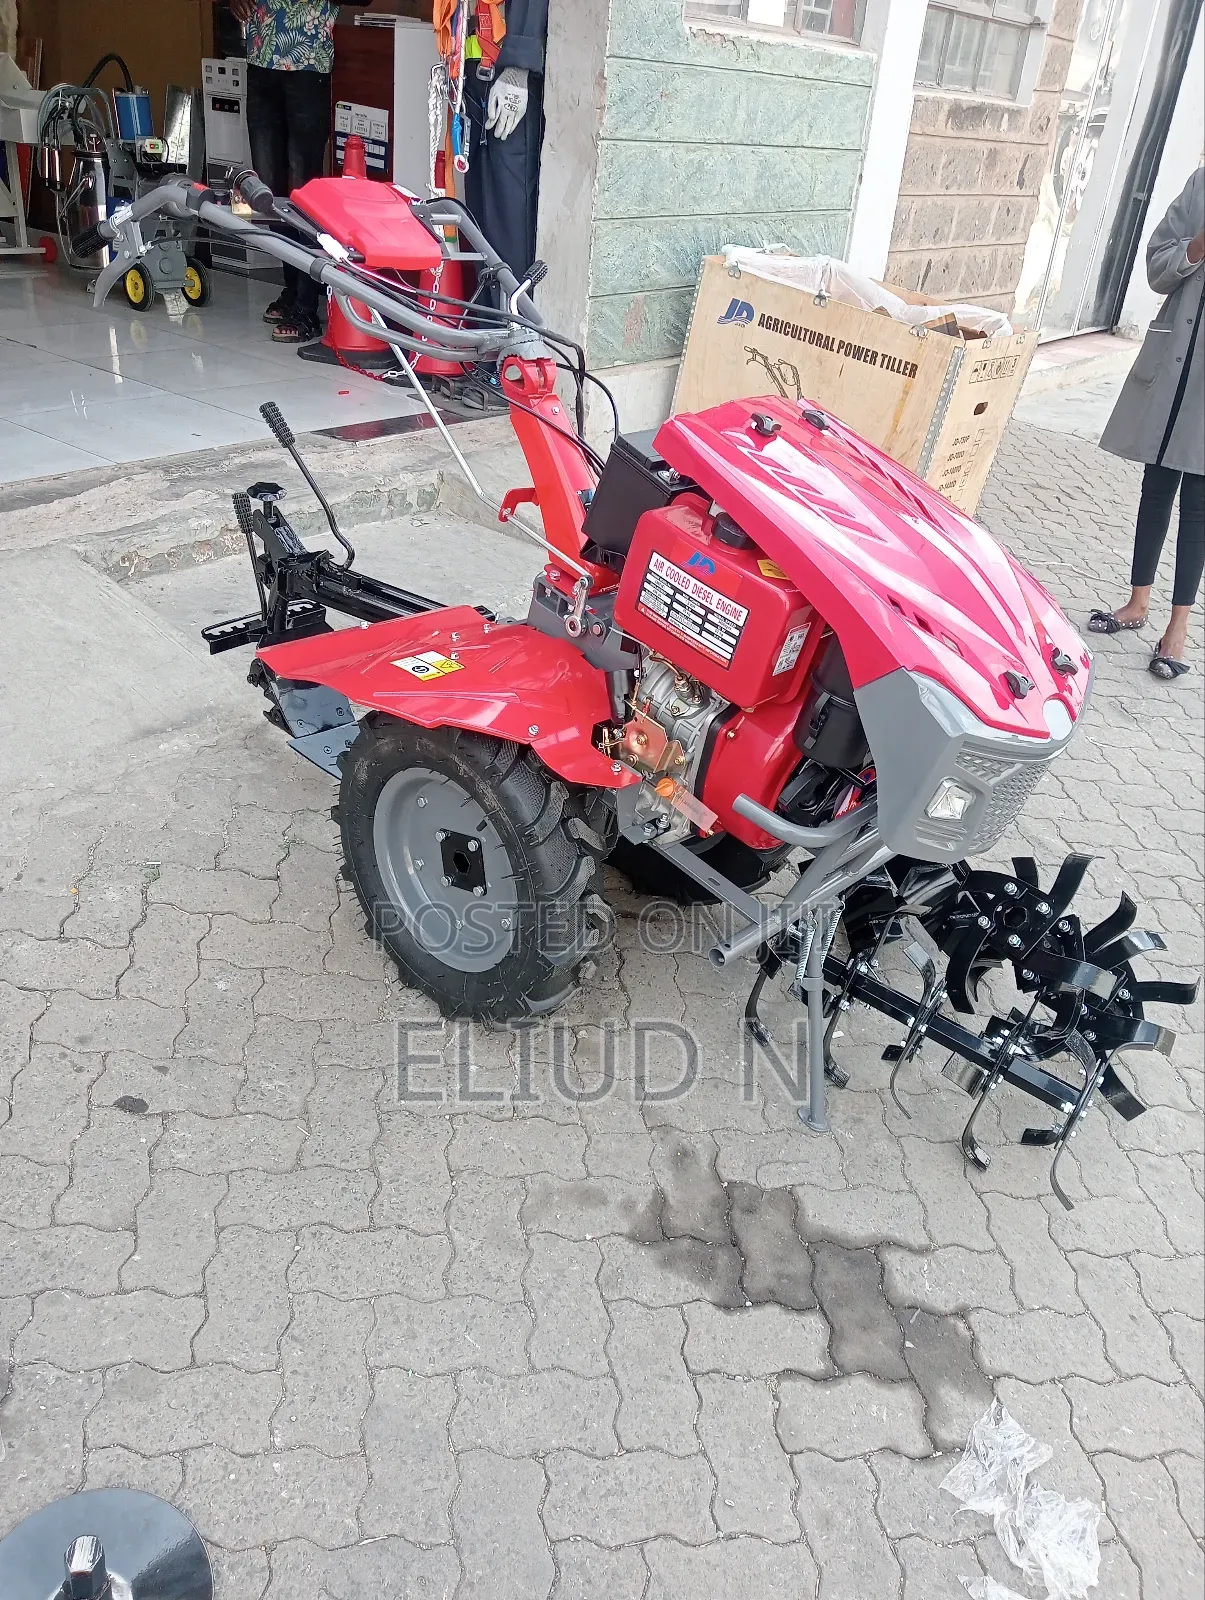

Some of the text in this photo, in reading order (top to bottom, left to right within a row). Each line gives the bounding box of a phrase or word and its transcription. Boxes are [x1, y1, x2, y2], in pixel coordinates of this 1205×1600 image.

[719, 297, 755, 323] JD
[757, 312, 919, 379] AGRICULTURAL POWER TILLER
[685, 551, 716, 577] JD
[653, 558, 665, 573] AIR
[665, 565, 691, 590] COOLED
[691, 582, 714, 606] DIESEL
[715, 598, 743, 622] ENGINE
